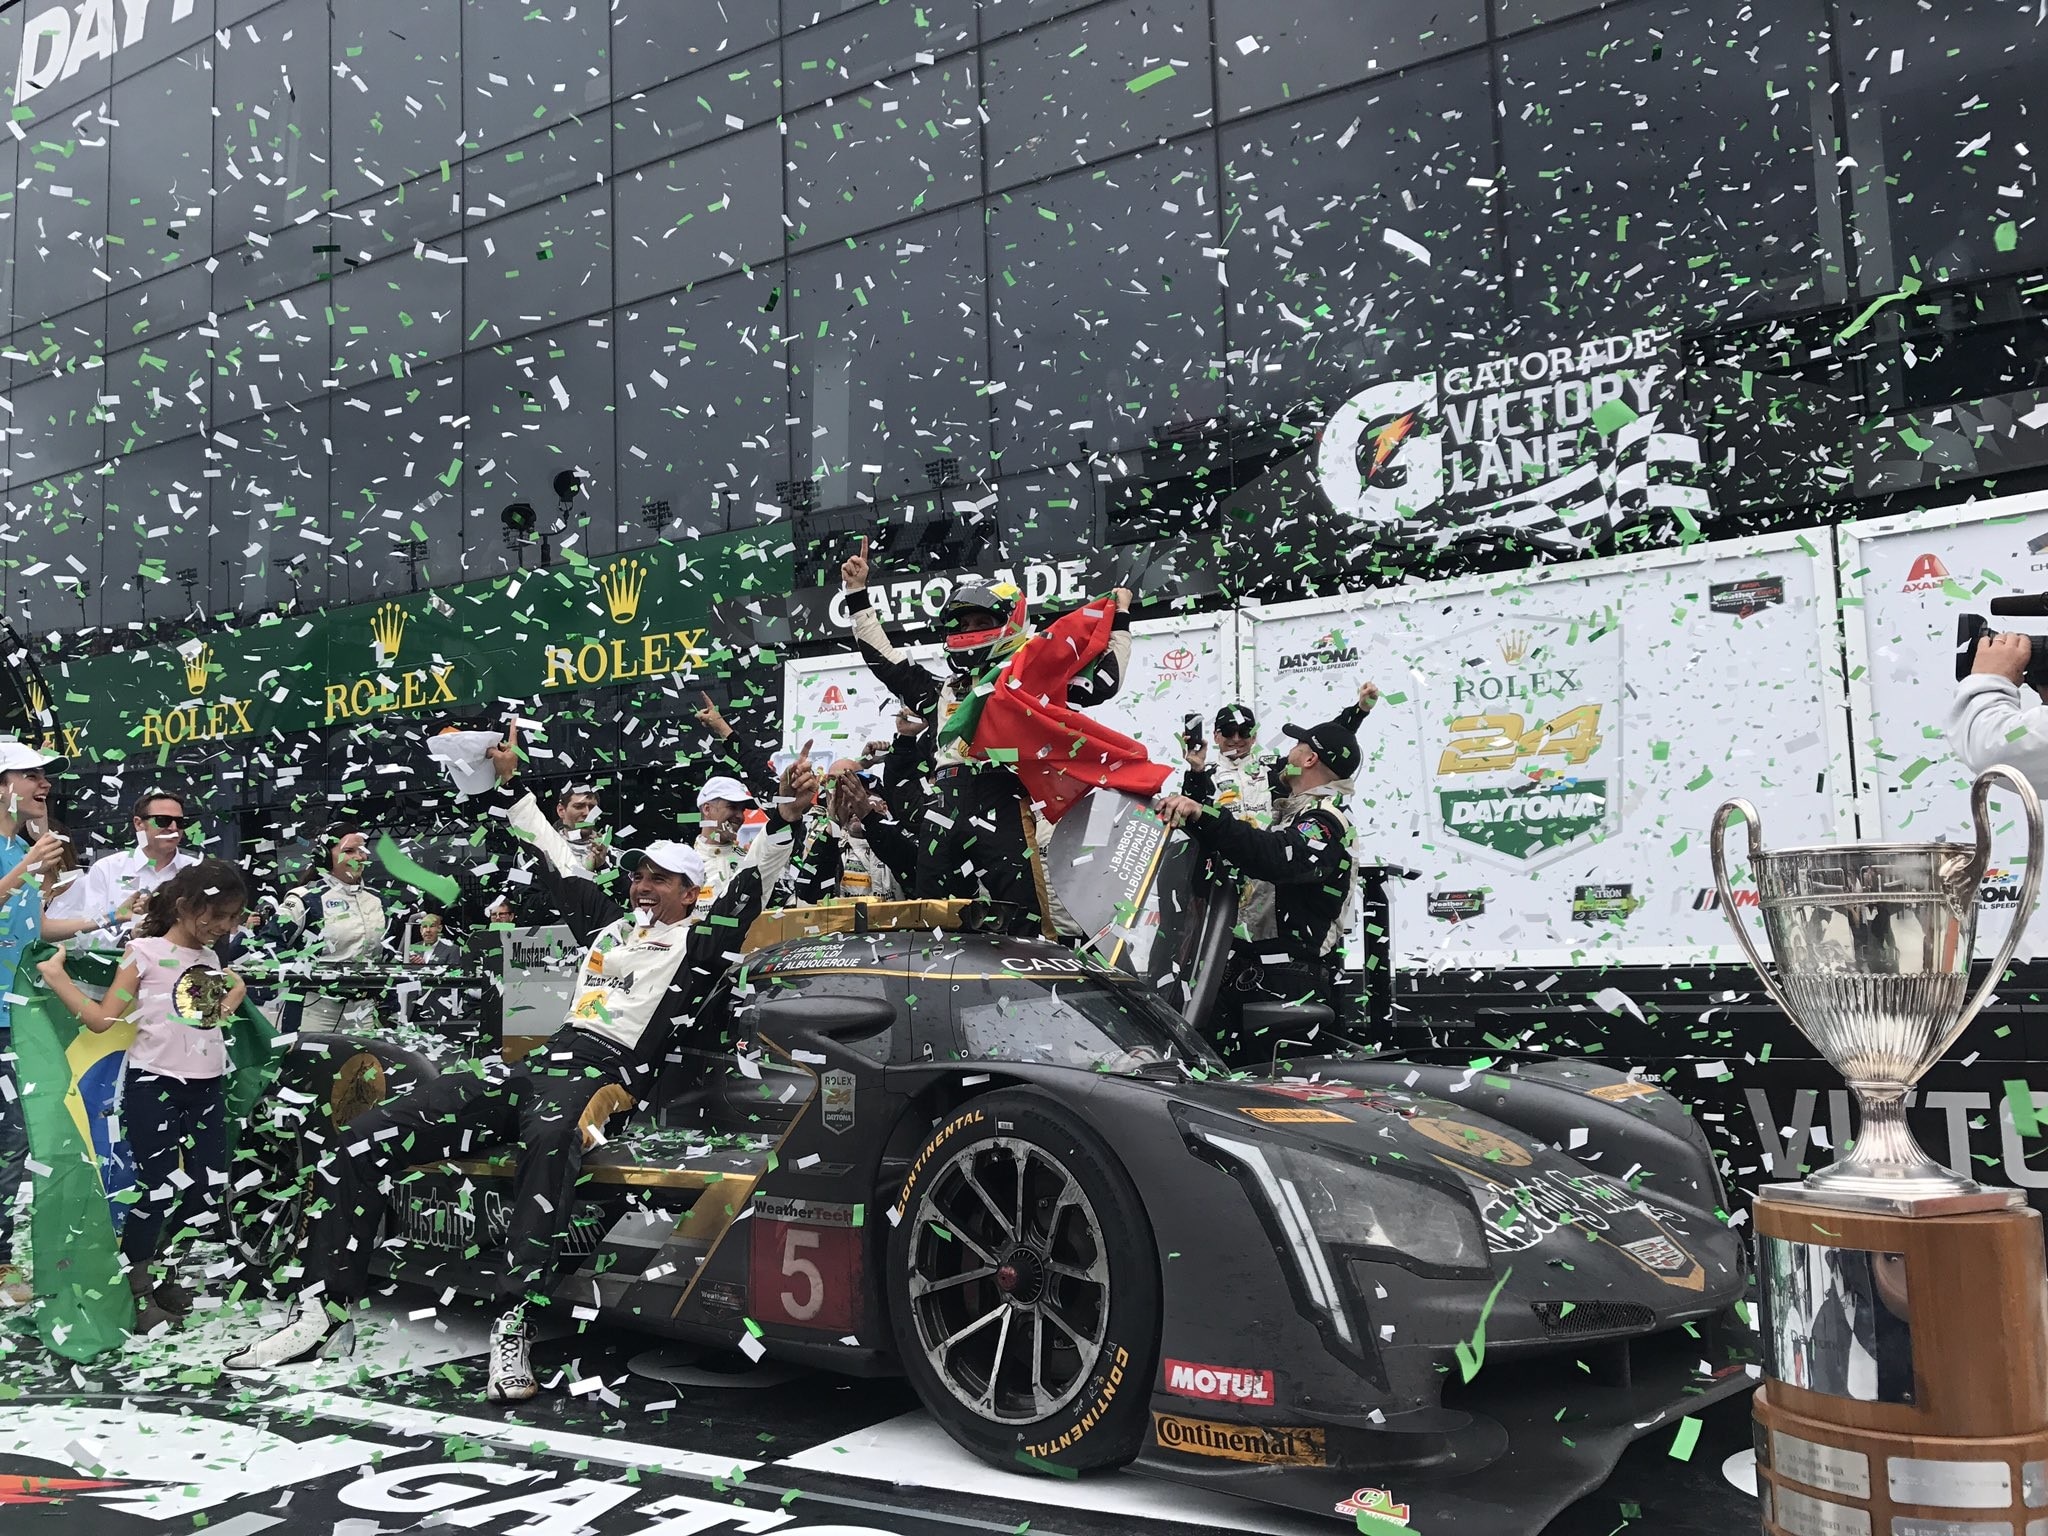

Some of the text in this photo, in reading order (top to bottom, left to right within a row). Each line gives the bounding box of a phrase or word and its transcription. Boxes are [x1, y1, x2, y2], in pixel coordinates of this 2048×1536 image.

[13, 0, 197, 106] DAY
[1443, 329, 1658, 395] GATORADE
[828, 560, 1088, 628] GATODE
[544, 628, 710, 687] ROLEX
[1158, 670, 1199, 682] TOYTA
[1279, 647, 1359, 669] DAYTONA
[325, 665, 457, 721] ROLEX
[818, 704, 848, 713] AXALTA
[1453, 669, 1578, 703] ROLEX
[142, 700, 254, 748] ROLEX
[1437, 704, 1603, 775] 24
[1451, 793, 1598, 825] DAYTONA
[1109, 819, 1139, 872] J.BARBOSA
[1119, 823, 1150, 881] C.FITTIPALDI
[1124, 828, 1161, 901] ALBUQUERQUE
[1991, 902, 2019, 910] SPEED
[783, 958, 861, 970] ALBUQUERQUE
[825, 1076, 852, 1086] ROLEX
[897, 1109, 985, 1218] CONTINENTAL
[754, 1200, 853, 1222] WeatherTech
[780, 1229, 825, 1321] 5
[1025, 1346, 1129, 1458] CONTINENTAL
[1170, 1365, 1269, 1399] MOTUL
[1157, 1416, 1298, 1457] Continental
[337, 1462, 906, 1536] GAT
